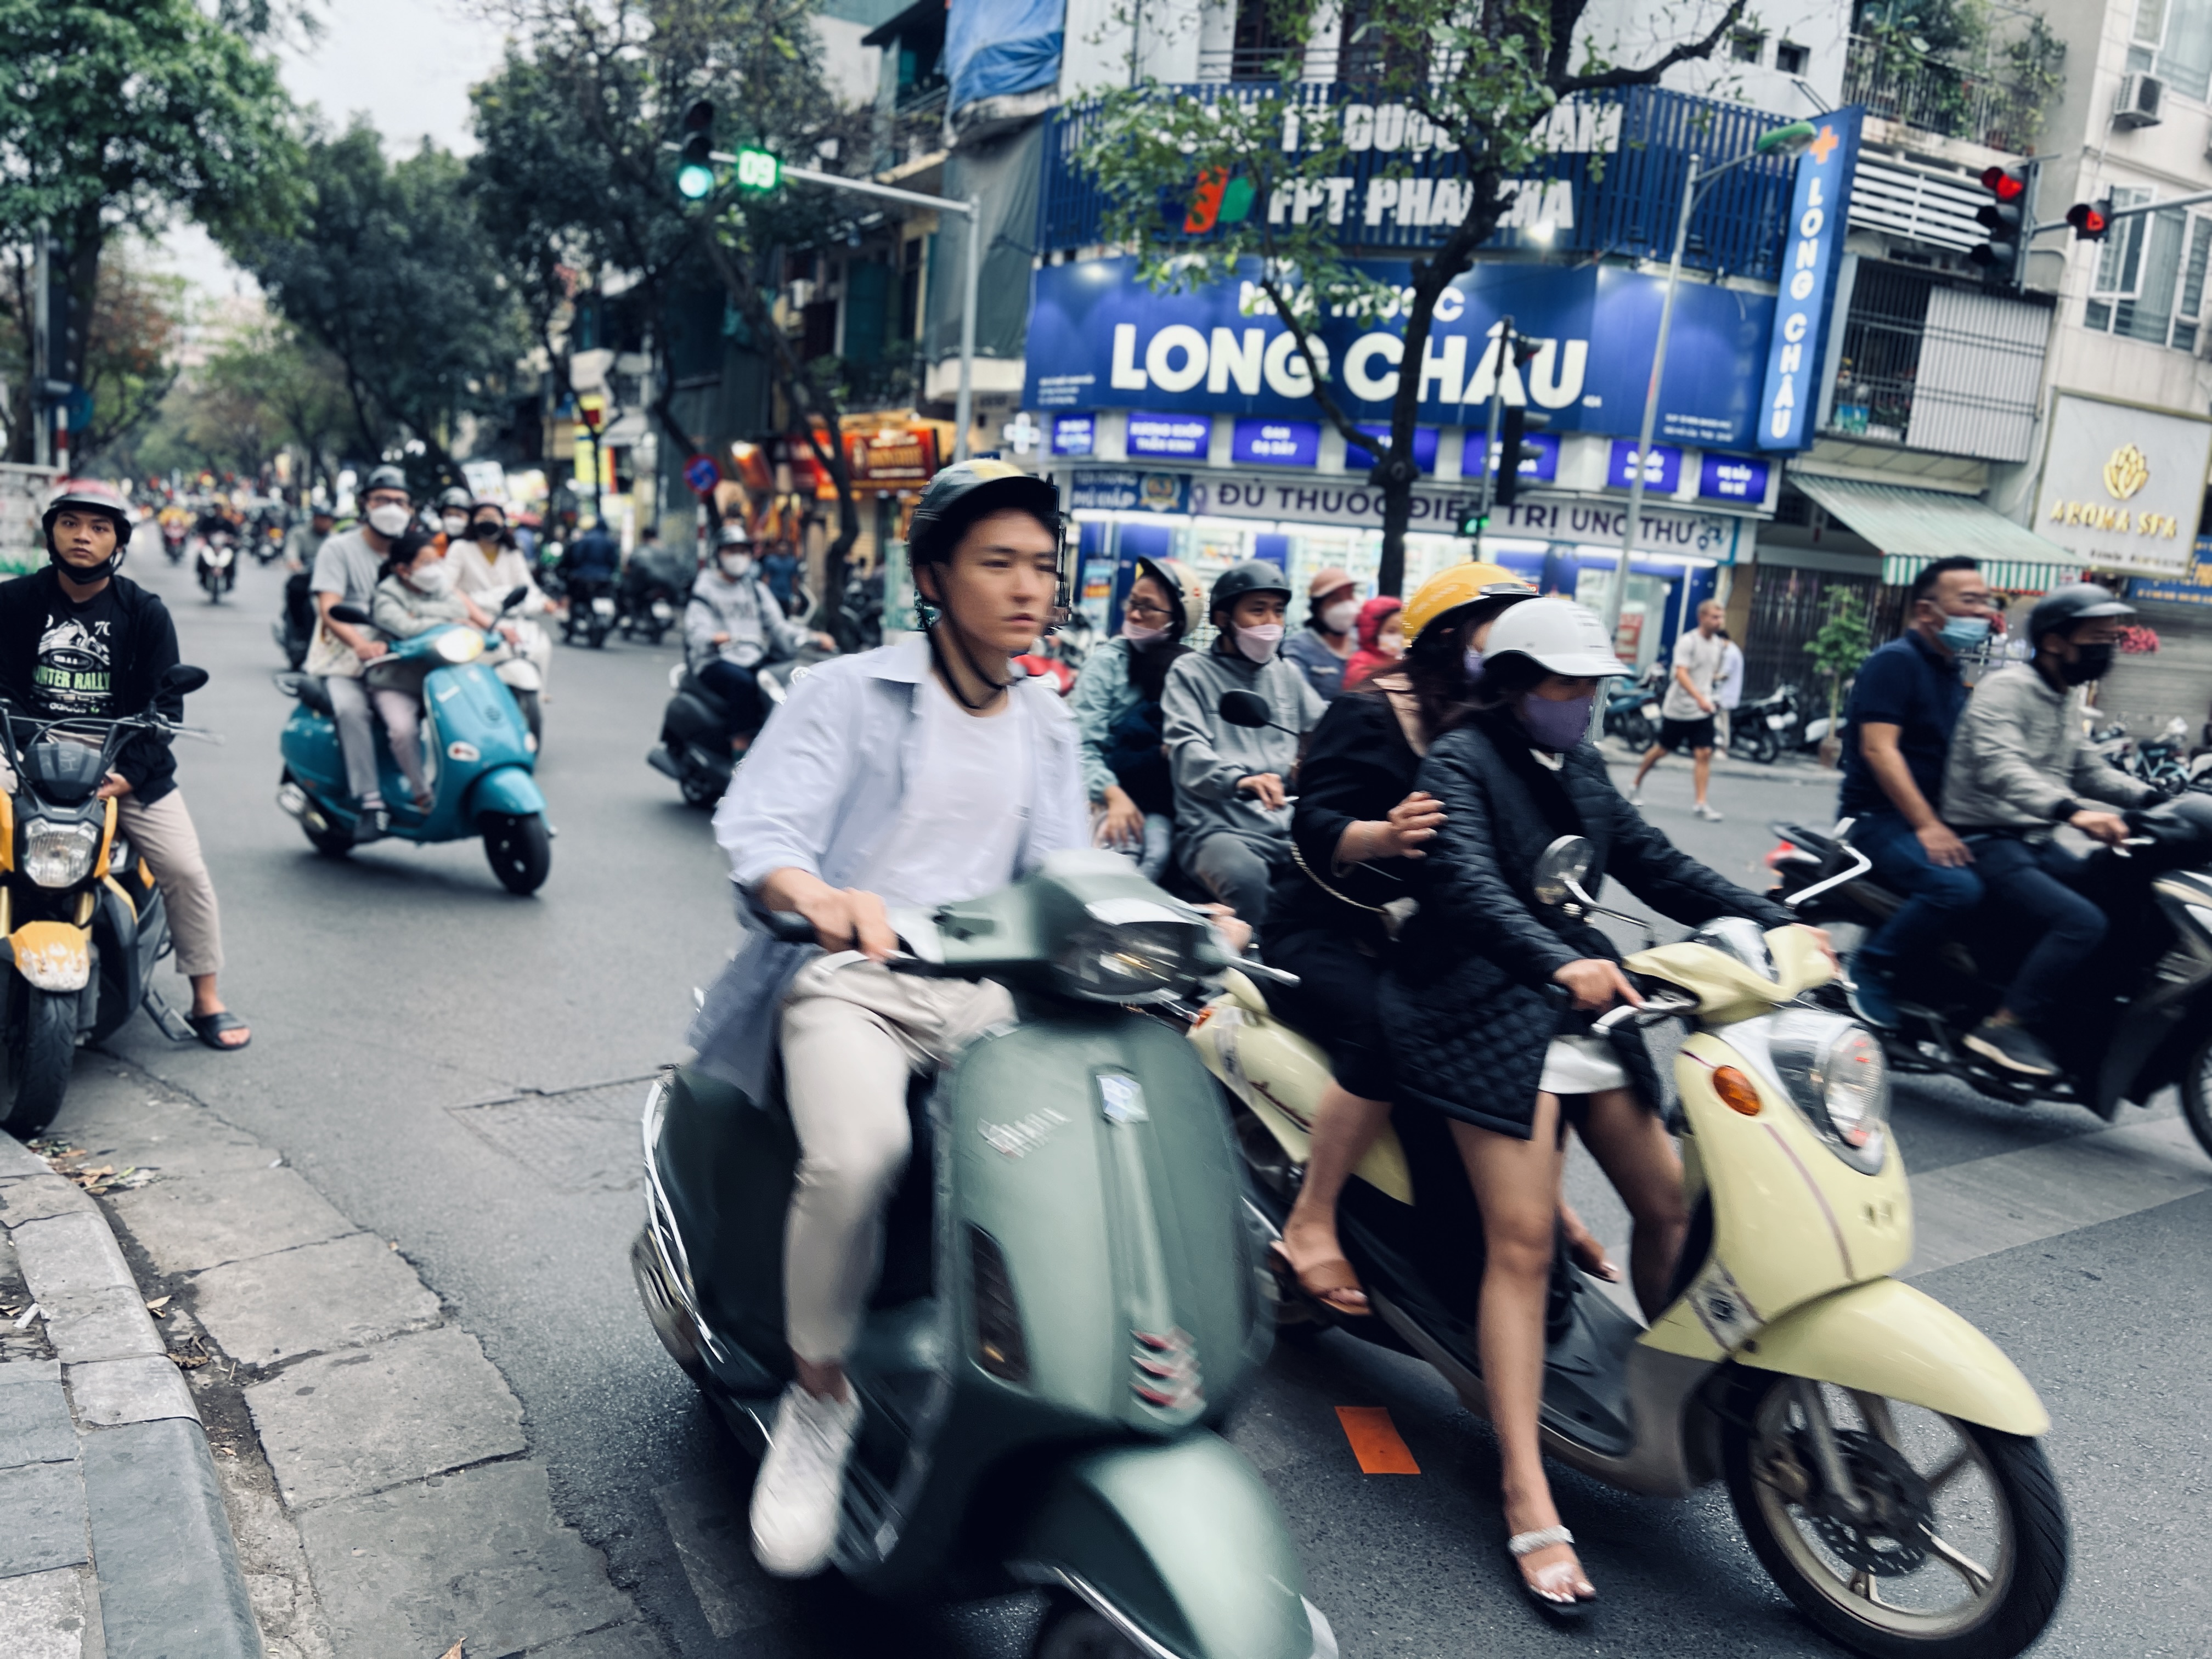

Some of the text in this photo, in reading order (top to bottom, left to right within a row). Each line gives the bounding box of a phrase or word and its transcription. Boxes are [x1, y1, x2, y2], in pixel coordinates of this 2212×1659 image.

[1268, 177, 1354, 225] FPT
[1770, 177, 1824, 439] LONG CHÂU
[1110, 324, 1330, 398] LONG
[1343, 320, 1589, 409] CHÂU
[1218, 478, 1266, 508] ĐỦ
[1506, 503, 1559, 536] TRỊ
[1639, 514, 1696, 544] THƯ
[2050, 499, 2176, 539] AROMA SPA
